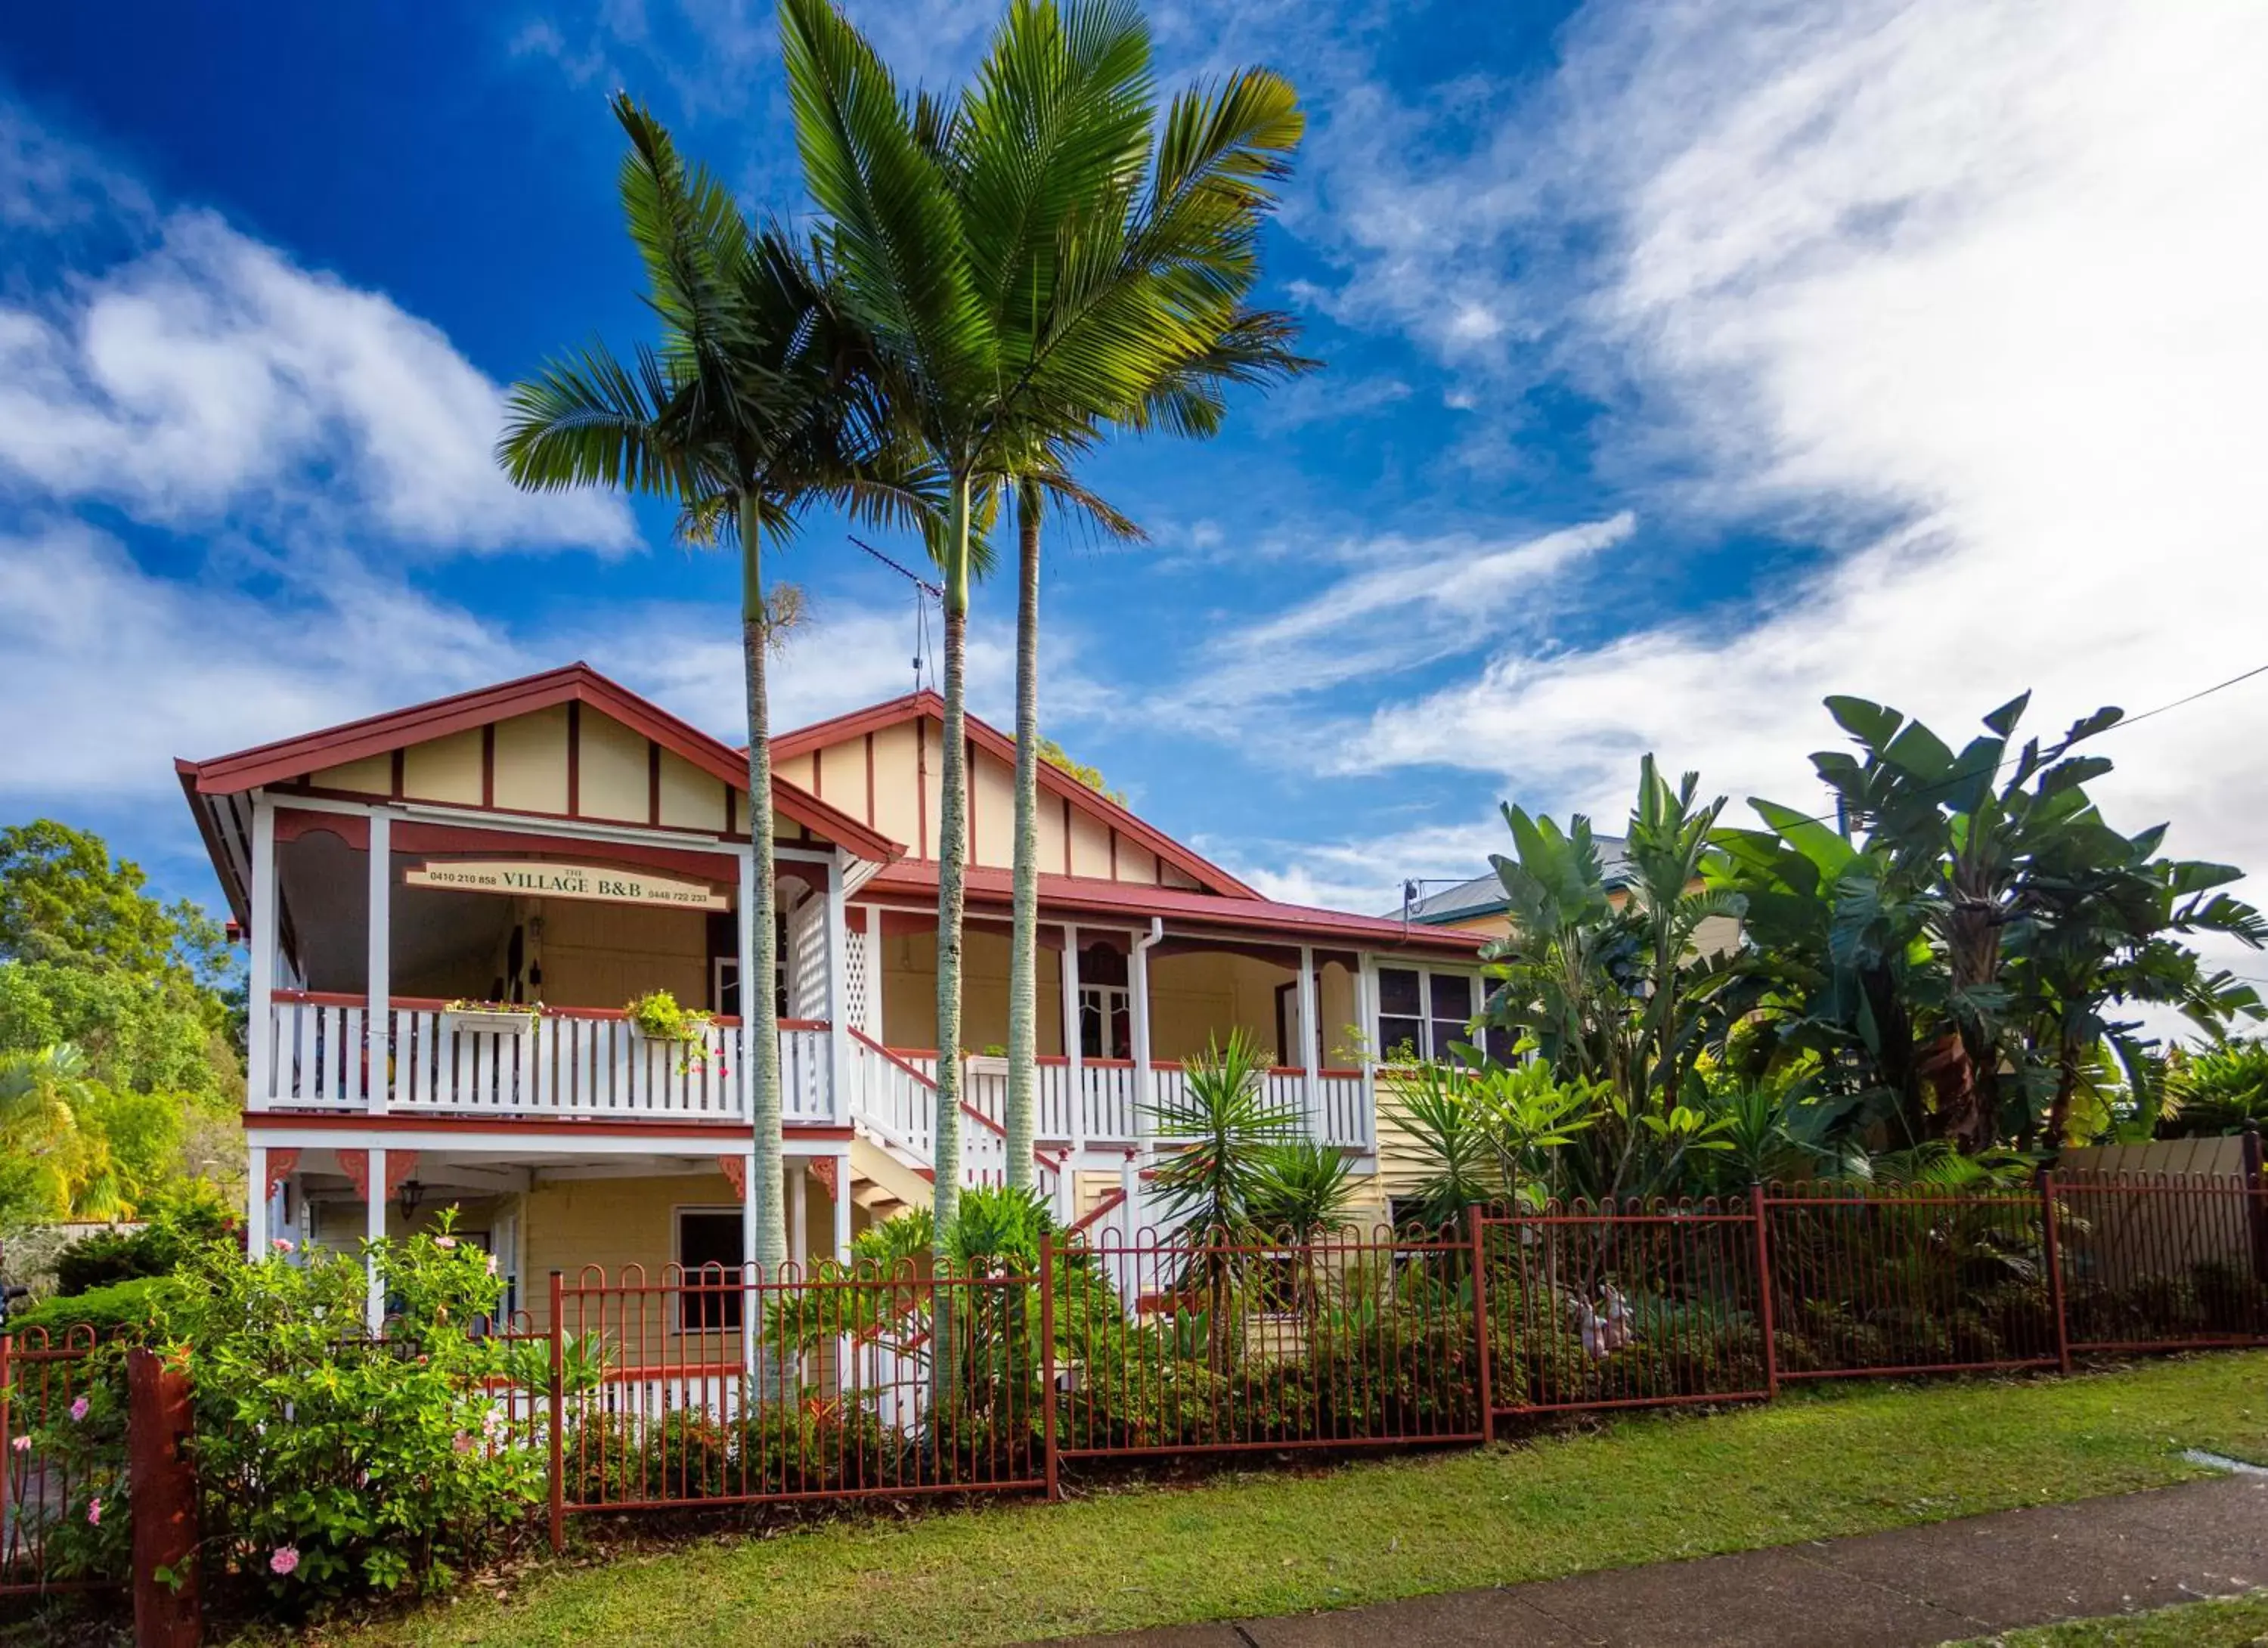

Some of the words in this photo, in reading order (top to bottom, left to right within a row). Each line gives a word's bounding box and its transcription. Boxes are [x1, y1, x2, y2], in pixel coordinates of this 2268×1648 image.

[430, 872, 454, 881] 0410
[457, 873, 476, 884] 210
[479, 875, 496, 884] 858
[503, 872, 588, 892] VILLAGE
[599, 881, 641, 897] B&B
[673, 891, 689, 902] 722
